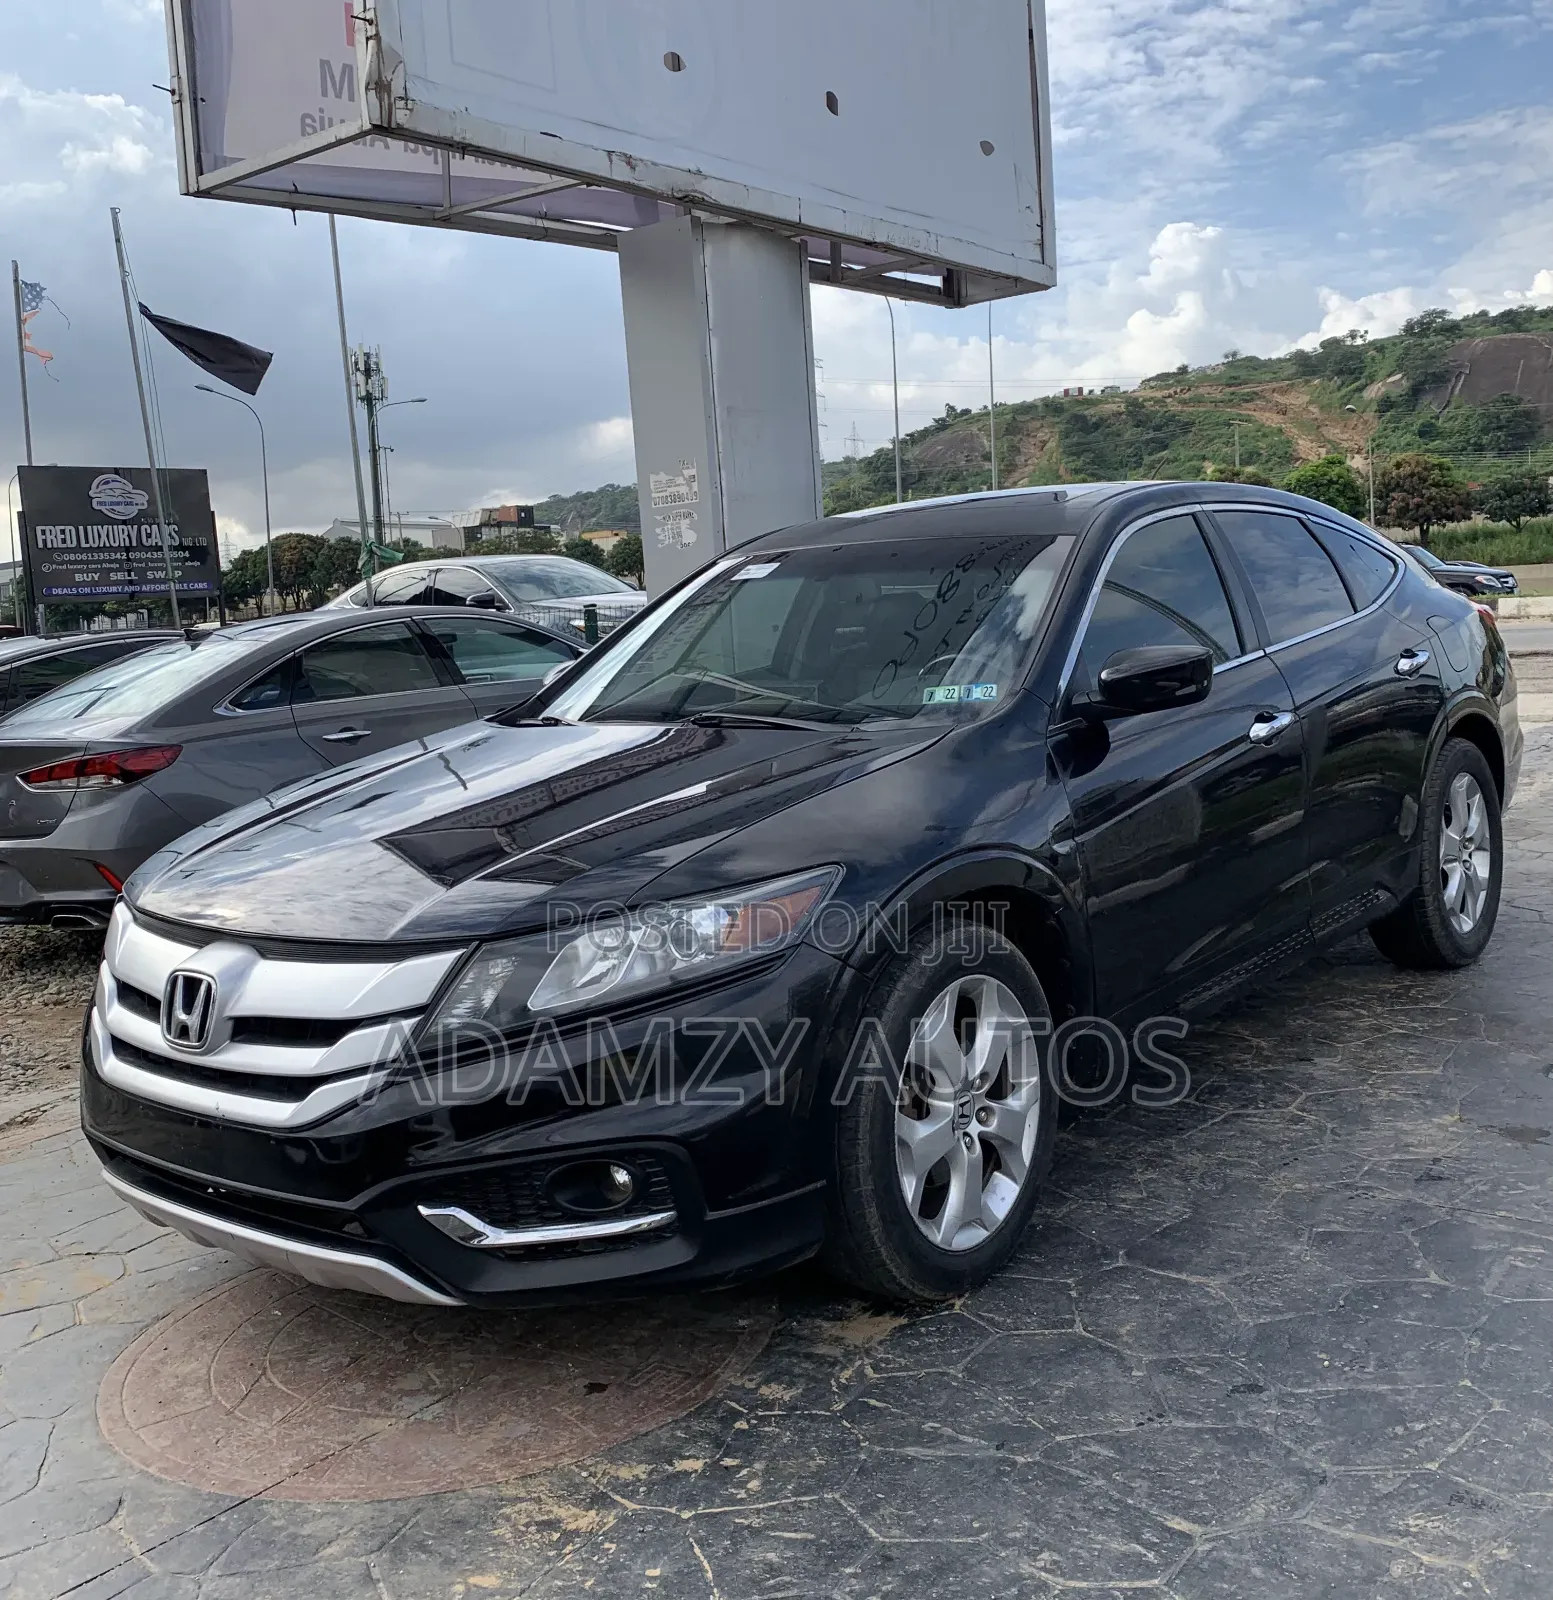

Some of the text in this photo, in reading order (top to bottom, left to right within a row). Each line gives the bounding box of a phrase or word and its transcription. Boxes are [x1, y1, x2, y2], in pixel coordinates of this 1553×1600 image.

[35, 525, 77, 549] FRED
[78, 524, 138, 549] LUXURY
[195, 536, 207, 547] LTD
[74, 570, 183, 582] BUY SELL SWP
[52, 587, 78, 595] DEALS
[91, 585, 123, 593] LUXURY
[123, 584, 140, 592] AND
[141, 583, 188, 592] AFFORDBLE
[188, 582, 208, 590] CARS
[945, 688, 956, 700] 22
[983, 685, 994, 698] 22
